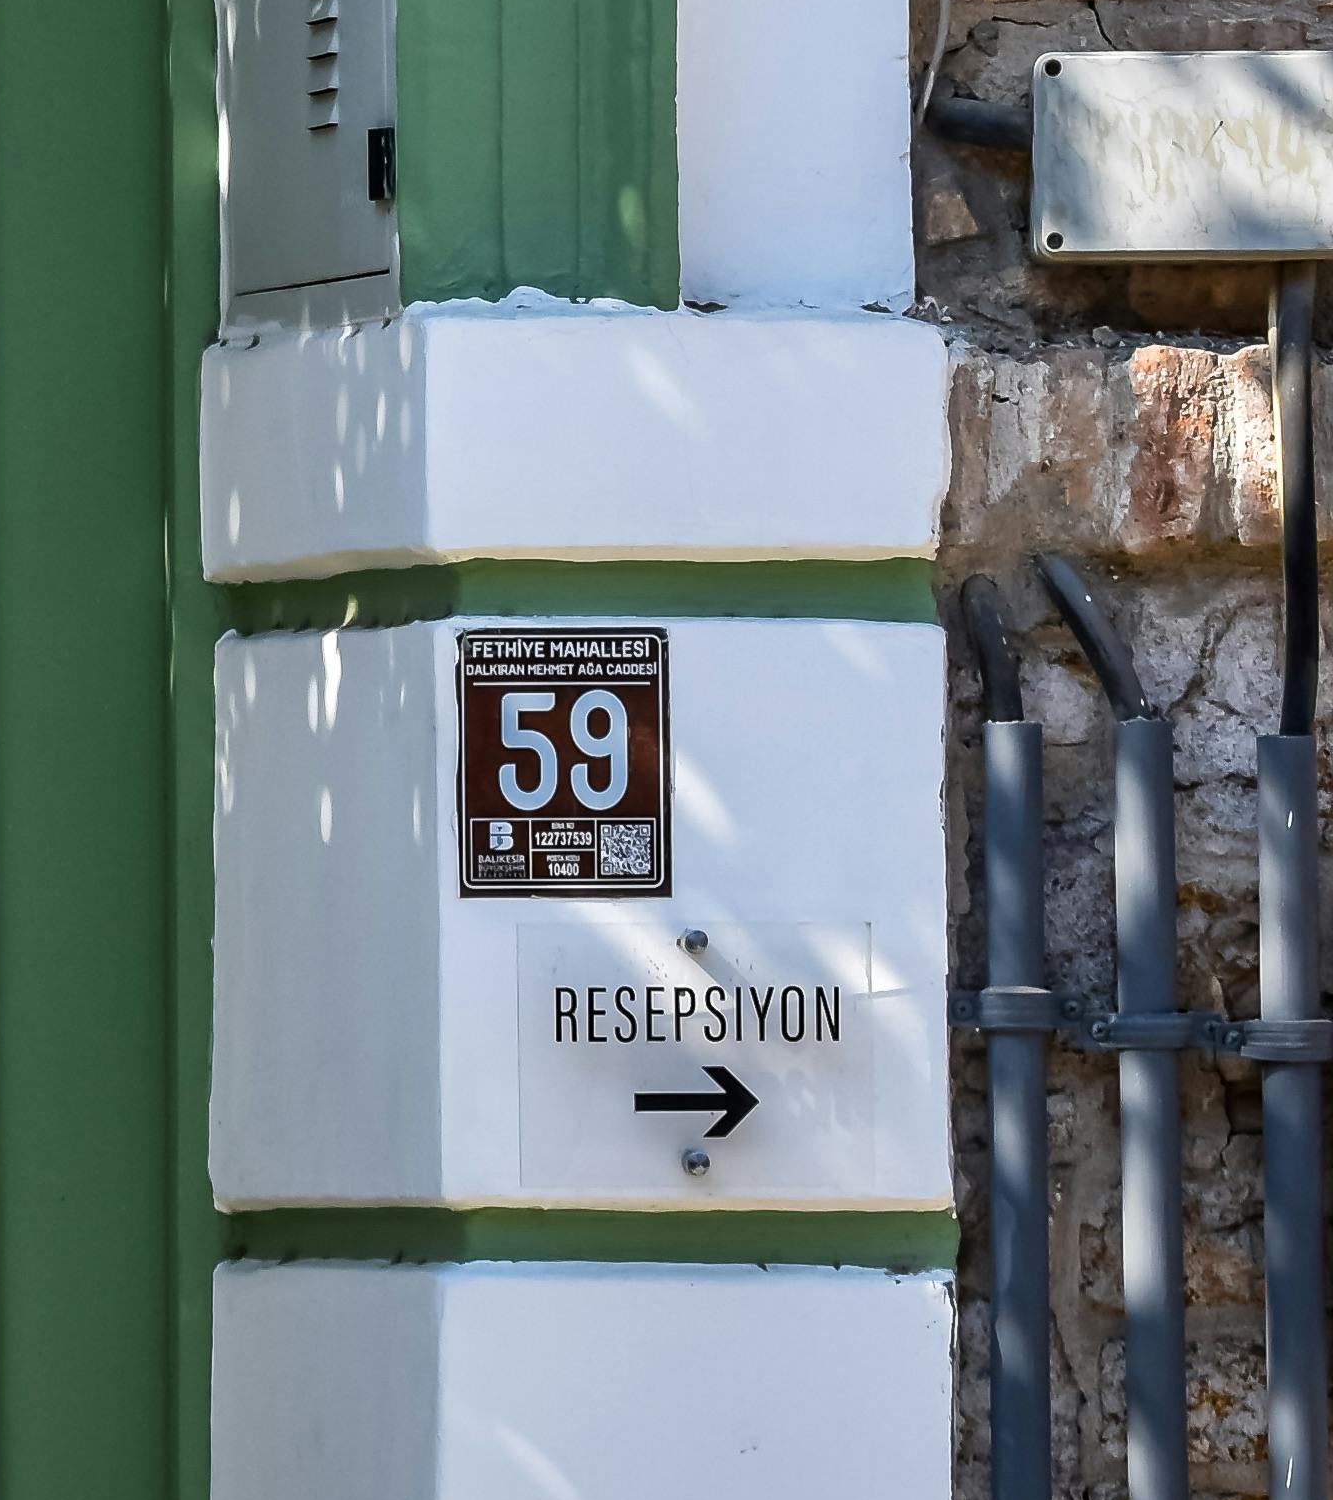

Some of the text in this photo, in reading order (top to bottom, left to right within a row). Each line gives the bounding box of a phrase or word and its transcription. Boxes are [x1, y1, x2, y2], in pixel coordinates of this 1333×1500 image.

[472, 637, 650, 659] FETHİYE MAHALLESİ
[527, 664, 574, 676] MEHMET
[577, 662, 603, 676] AĞA
[606, 661, 657, 675] CADDESİ
[498, 689, 629, 811] 59
[534, 831, 593, 846] 122737539
[548, 862, 580, 876] 10400
[554, 985, 841, 1043] RESEPSIYON
